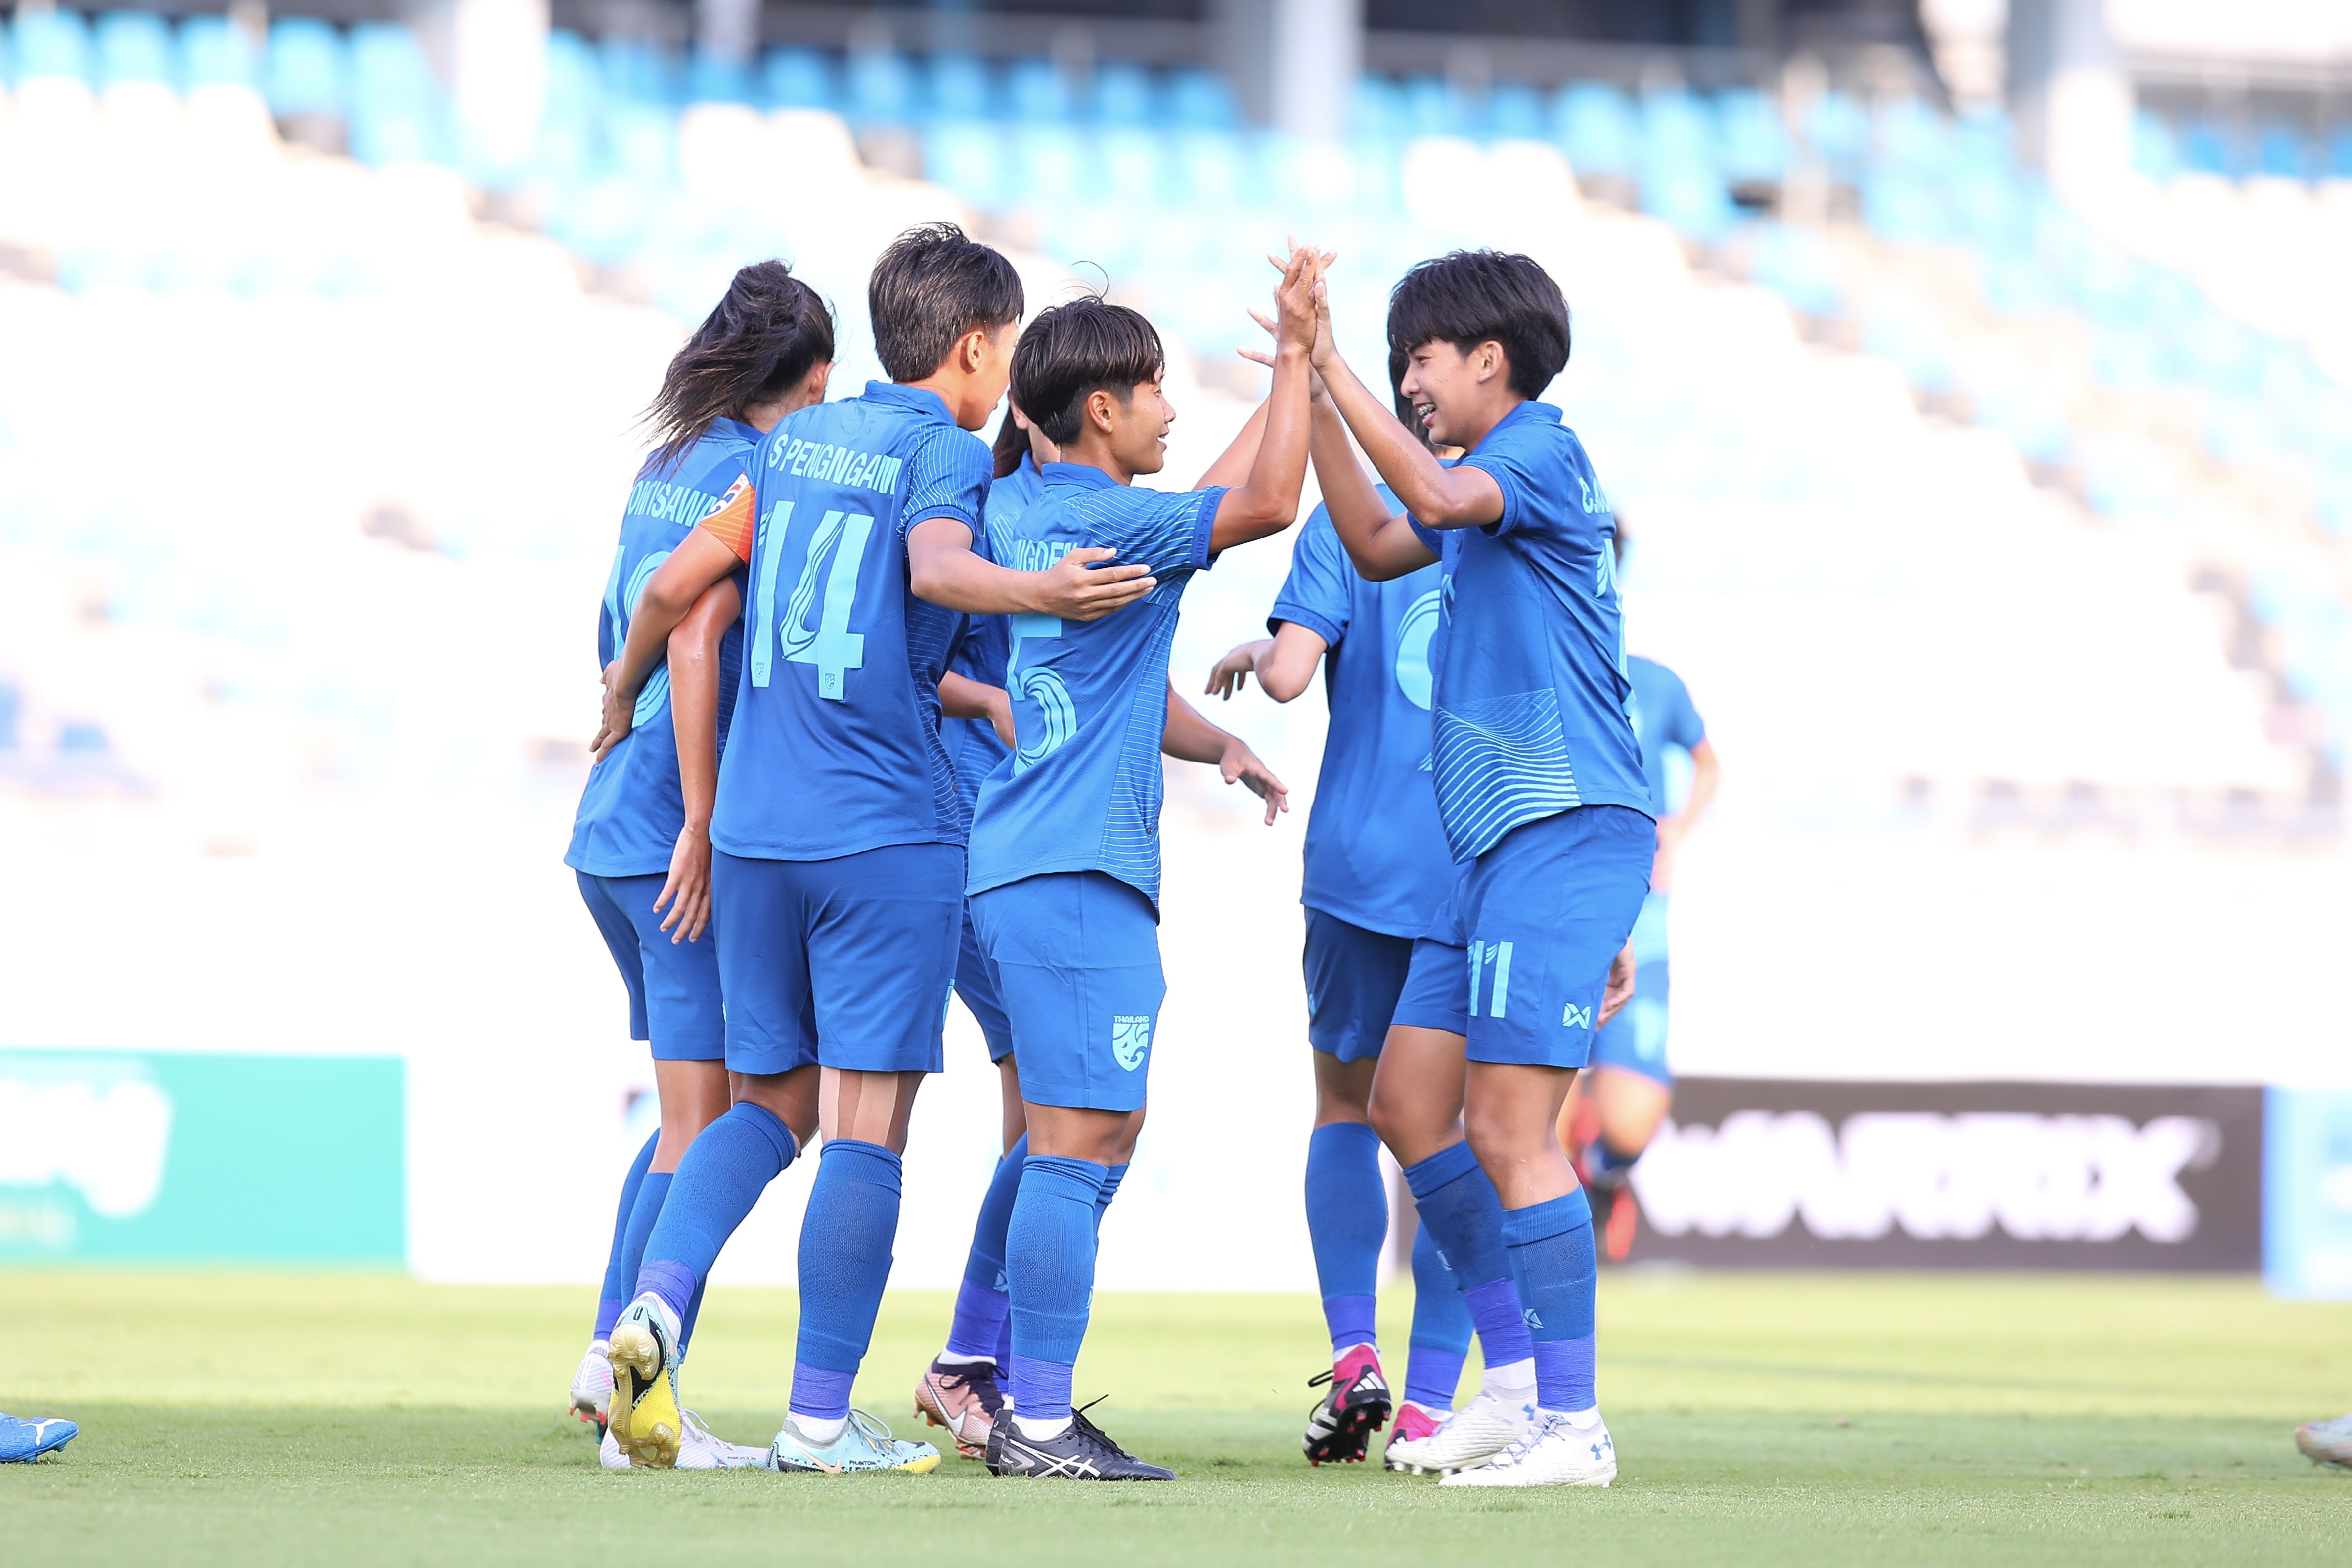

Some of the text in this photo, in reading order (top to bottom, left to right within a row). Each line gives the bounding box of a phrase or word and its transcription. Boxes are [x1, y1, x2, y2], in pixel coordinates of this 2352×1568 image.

[751, 501, 874, 700] 14
[1006, 613, 1077, 778] 5
[1468, 940, 1514, 1018] 11
